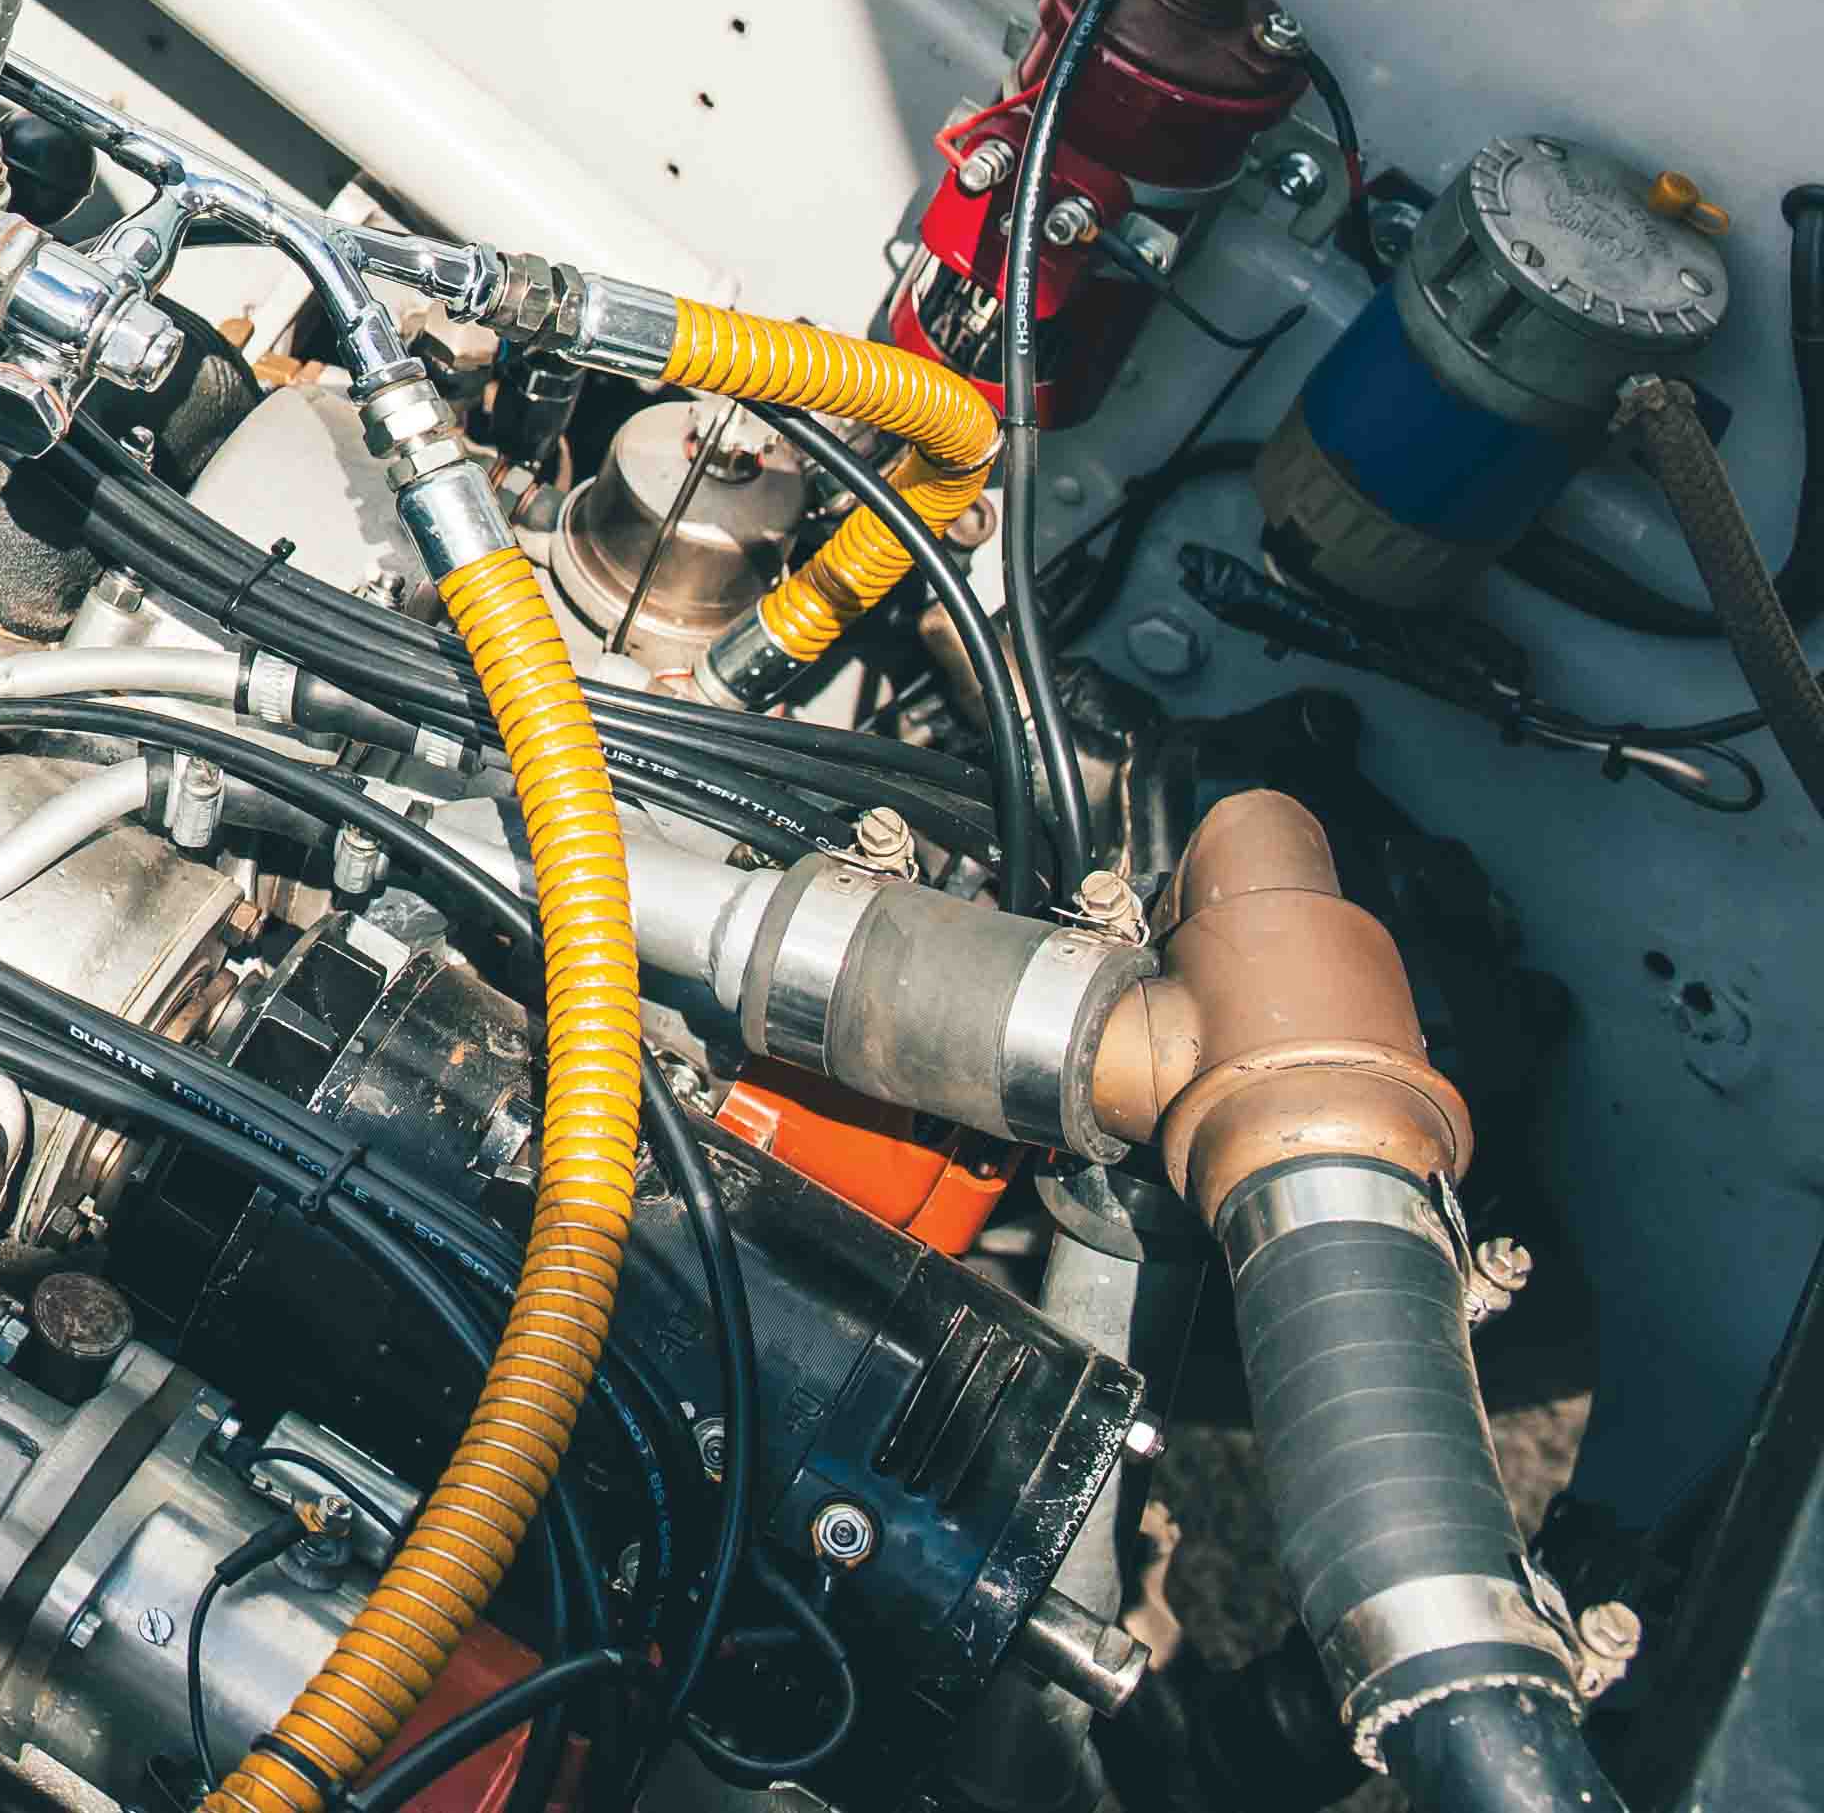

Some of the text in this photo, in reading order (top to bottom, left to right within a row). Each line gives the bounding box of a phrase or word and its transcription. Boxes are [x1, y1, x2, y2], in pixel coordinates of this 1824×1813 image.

[1016, 266, 1032, 356] (REACH)
[602, 745, 681, 780] URITE
[695, 778, 806, 834] IGNITION
[69, 1023, 157, 1080] DURITE
[172, 1080, 288, 1154] IGNITION
[295, 1153, 369, 1204] CALE
